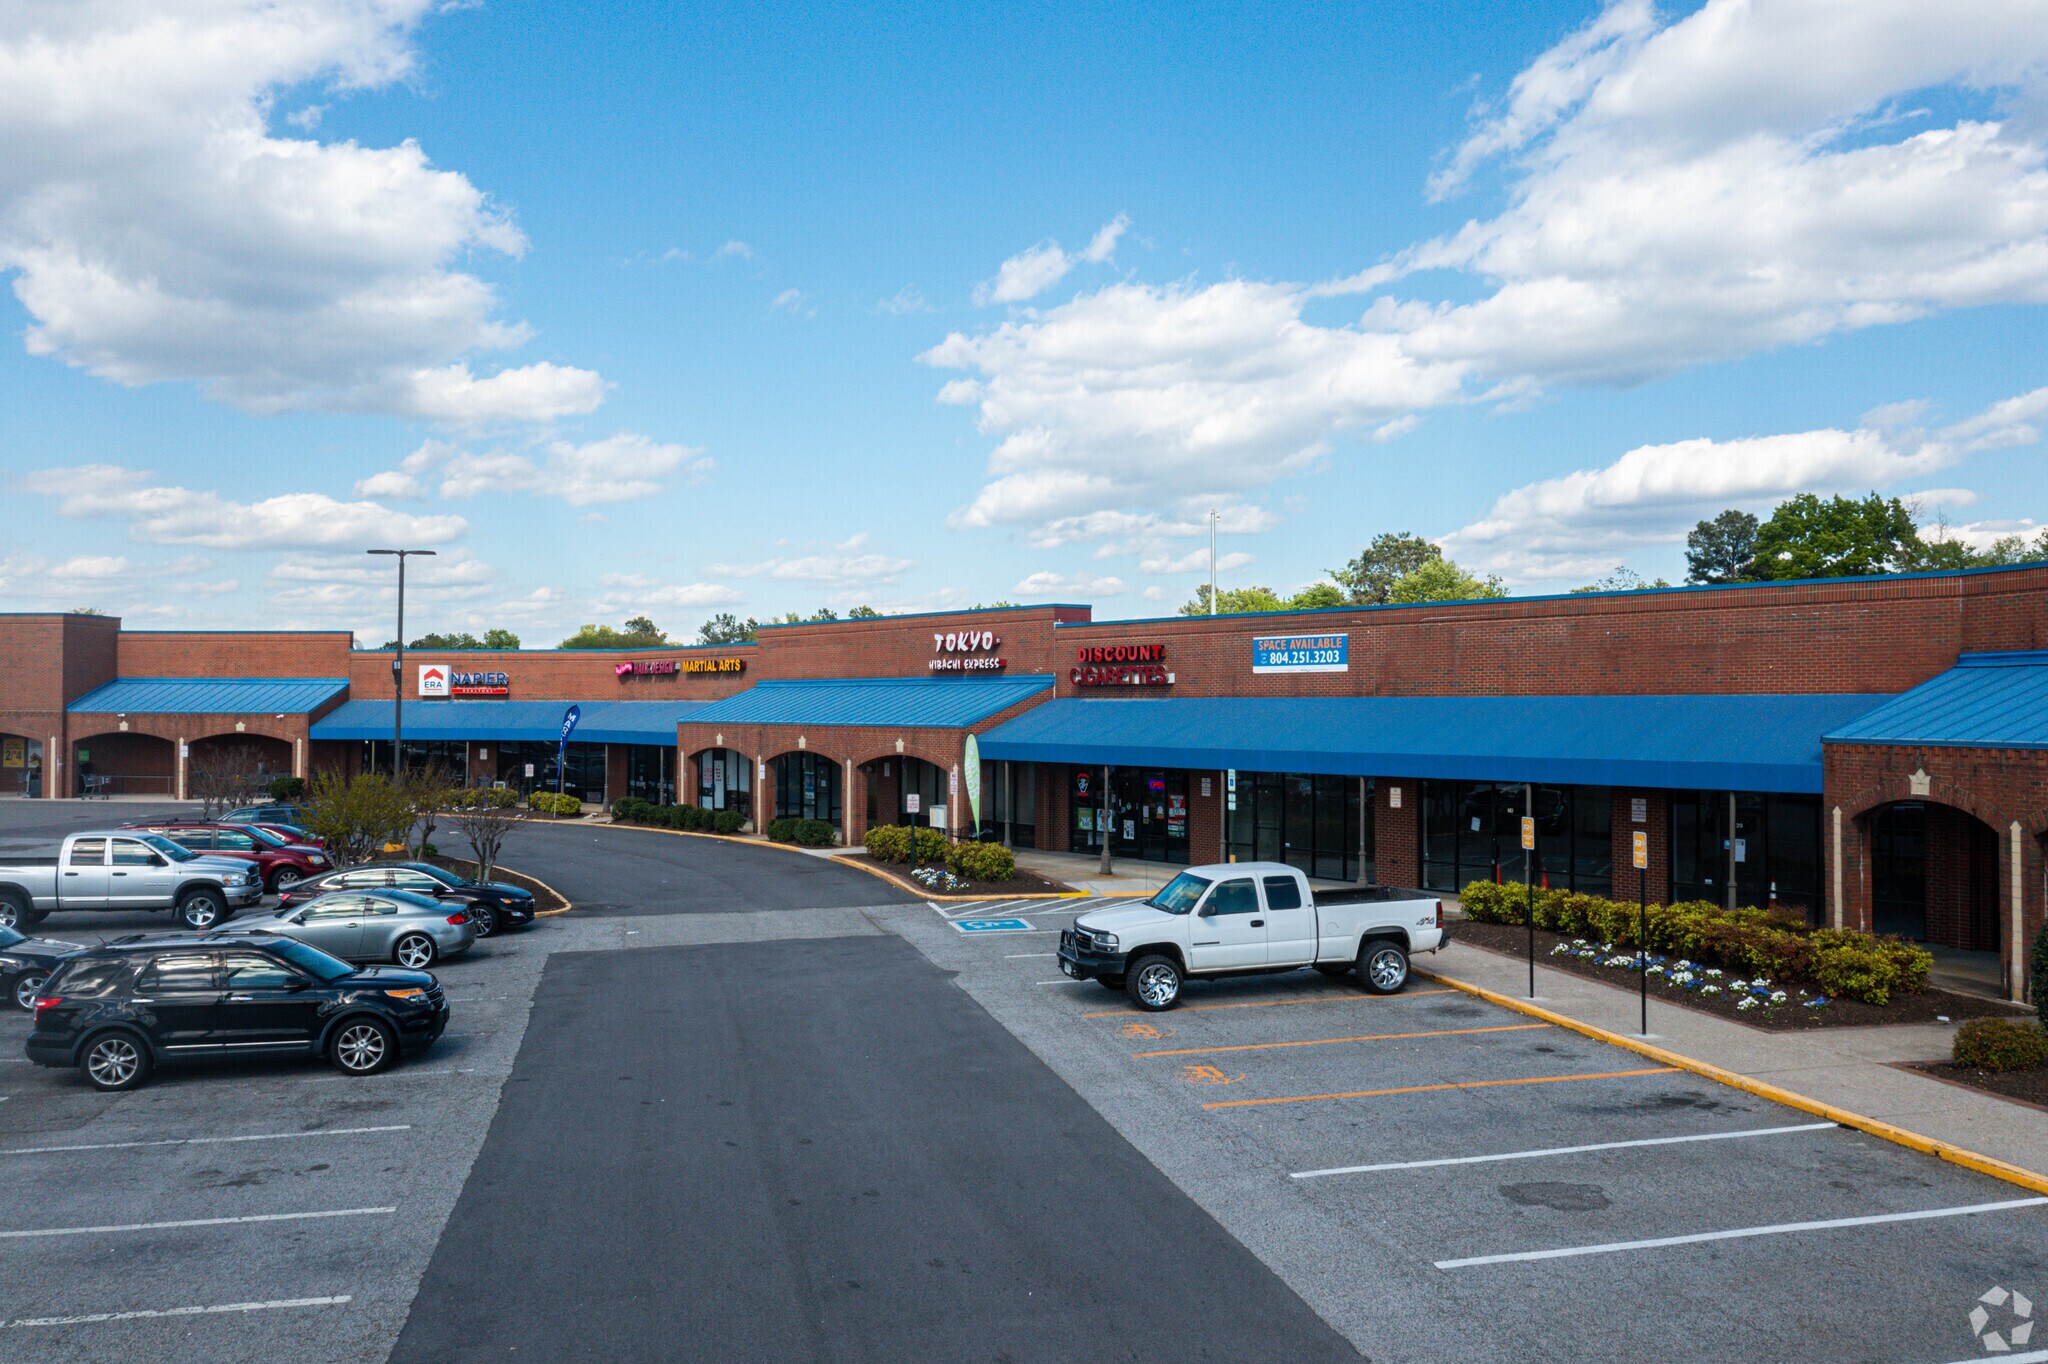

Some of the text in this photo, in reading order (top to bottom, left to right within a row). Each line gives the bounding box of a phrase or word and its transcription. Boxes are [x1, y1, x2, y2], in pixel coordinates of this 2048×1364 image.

[934, 631, 993, 652] TOKYO
[1258, 638, 1342, 651] SPACE AVAILABLE
[1077, 645, 1164, 662] DISCOUNT
[1270, 650, 1340, 664] 804.251.3203
[683, 659, 741, 673] MARTIAL ARTS
[929, 657, 999, 670] HIBACHI EXPRESS
[451, 672, 508, 685] NAPIER
[1070, 666, 1168, 685] CIGARETTES
[424, 681, 443, 689] ERA
